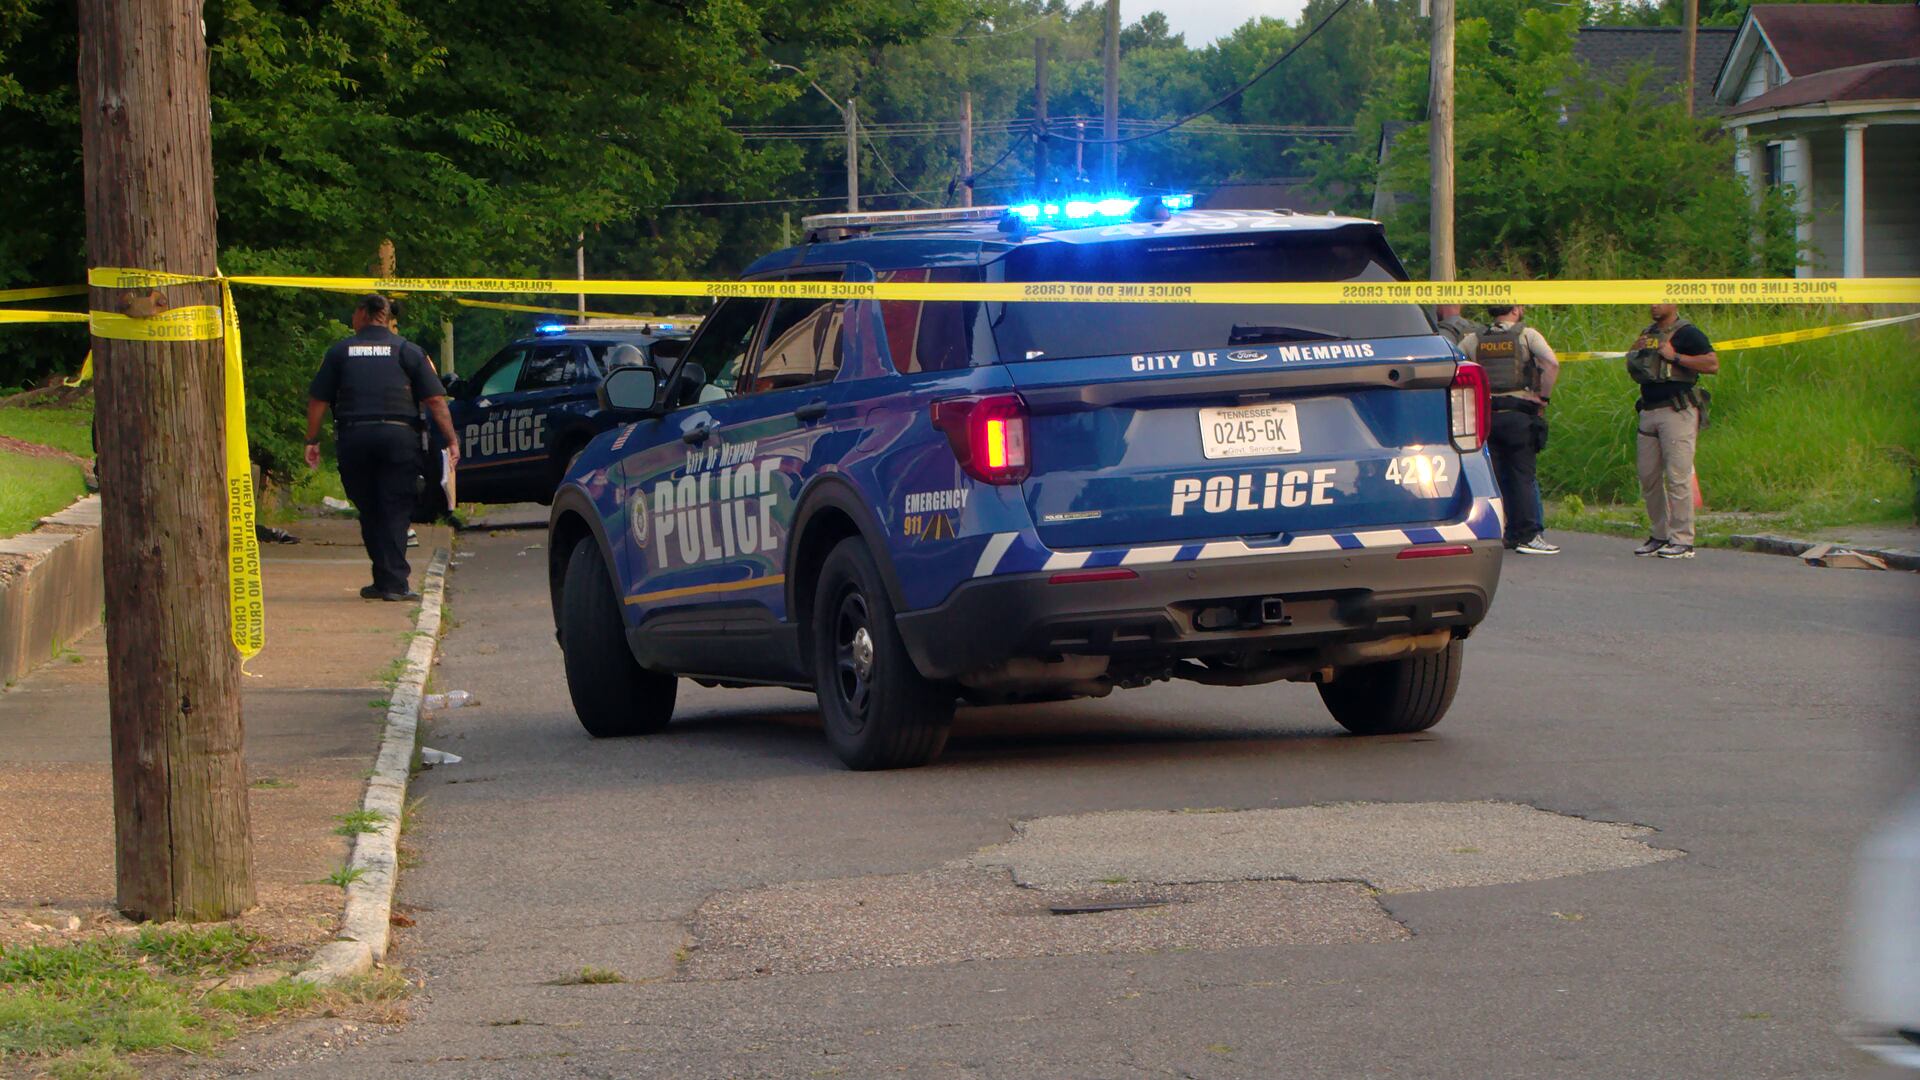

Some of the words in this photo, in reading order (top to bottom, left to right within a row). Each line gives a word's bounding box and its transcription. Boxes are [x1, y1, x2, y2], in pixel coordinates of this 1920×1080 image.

[373, 345, 391, 357] POLICE
[1131, 354, 1181, 372] CITY
[1191, 351, 1218, 368] OF
[1278, 343, 1375, 362] MEMPHIS
[1480, 341, 1513, 352] POLICE
[1222, 408, 1272, 420] TENNESSEE
[465, 413, 547, 458] POLICE
[1213, 418, 1287, 445] 0245-GK
[685, 450, 704, 474] CITY
[706, 446, 719, 470] OF
[718, 440, 758, 467] MEMPHIS
[1386, 455, 1449, 484] 422
[905, 488, 969, 514] EMERGENCY
[1170, 468, 1337, 516] POLICE
[654, 456, 783, 569] POLICE
[903, 515, 922, 536] 911
